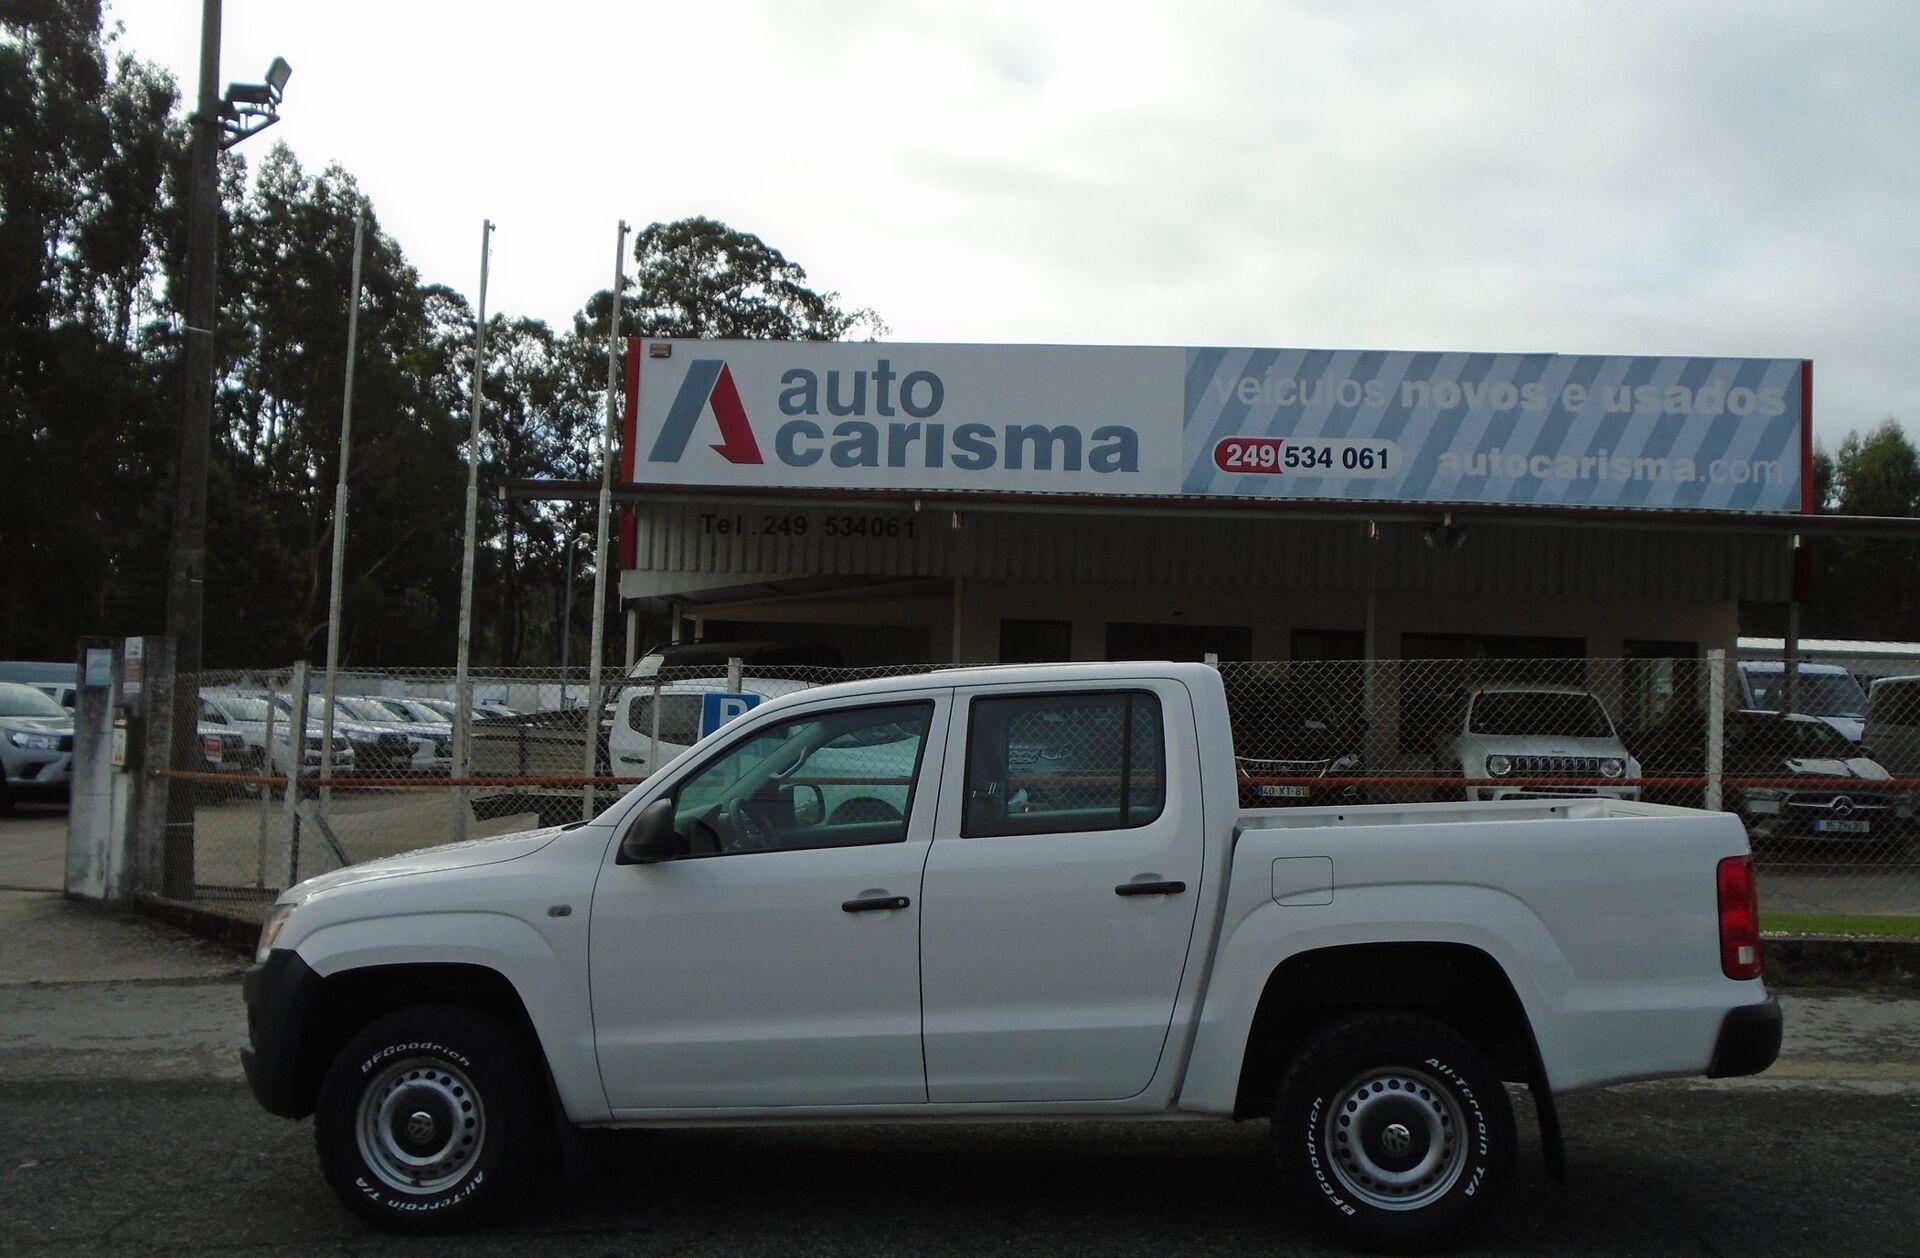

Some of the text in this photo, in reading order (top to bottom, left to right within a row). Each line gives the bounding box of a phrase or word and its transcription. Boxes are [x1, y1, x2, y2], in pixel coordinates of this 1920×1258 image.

[778, 359, 945, 418] auto
[1401, 378, 1547, 412] novos
[1561, 382, 1587, 412] e
[1603, 376, 1787, 417] usados
[774, 419, 1139, 473] carisma
[1226, 443, 1389, 470] 249 534 061
[1437, 446, 1783, 484] autocarisma.com
[825, 516, 915, 538] 534061
[720, 698, 748, 728] P
[361, 1042, 470, 1073] BFGoodrich
[1424, 1057, 1488, 1197] All-Terrain T/A
[1307, 1096, 1357, 1216] BFGoodrich
[355, 1170, 484, 1210] All-Terrain T/A
